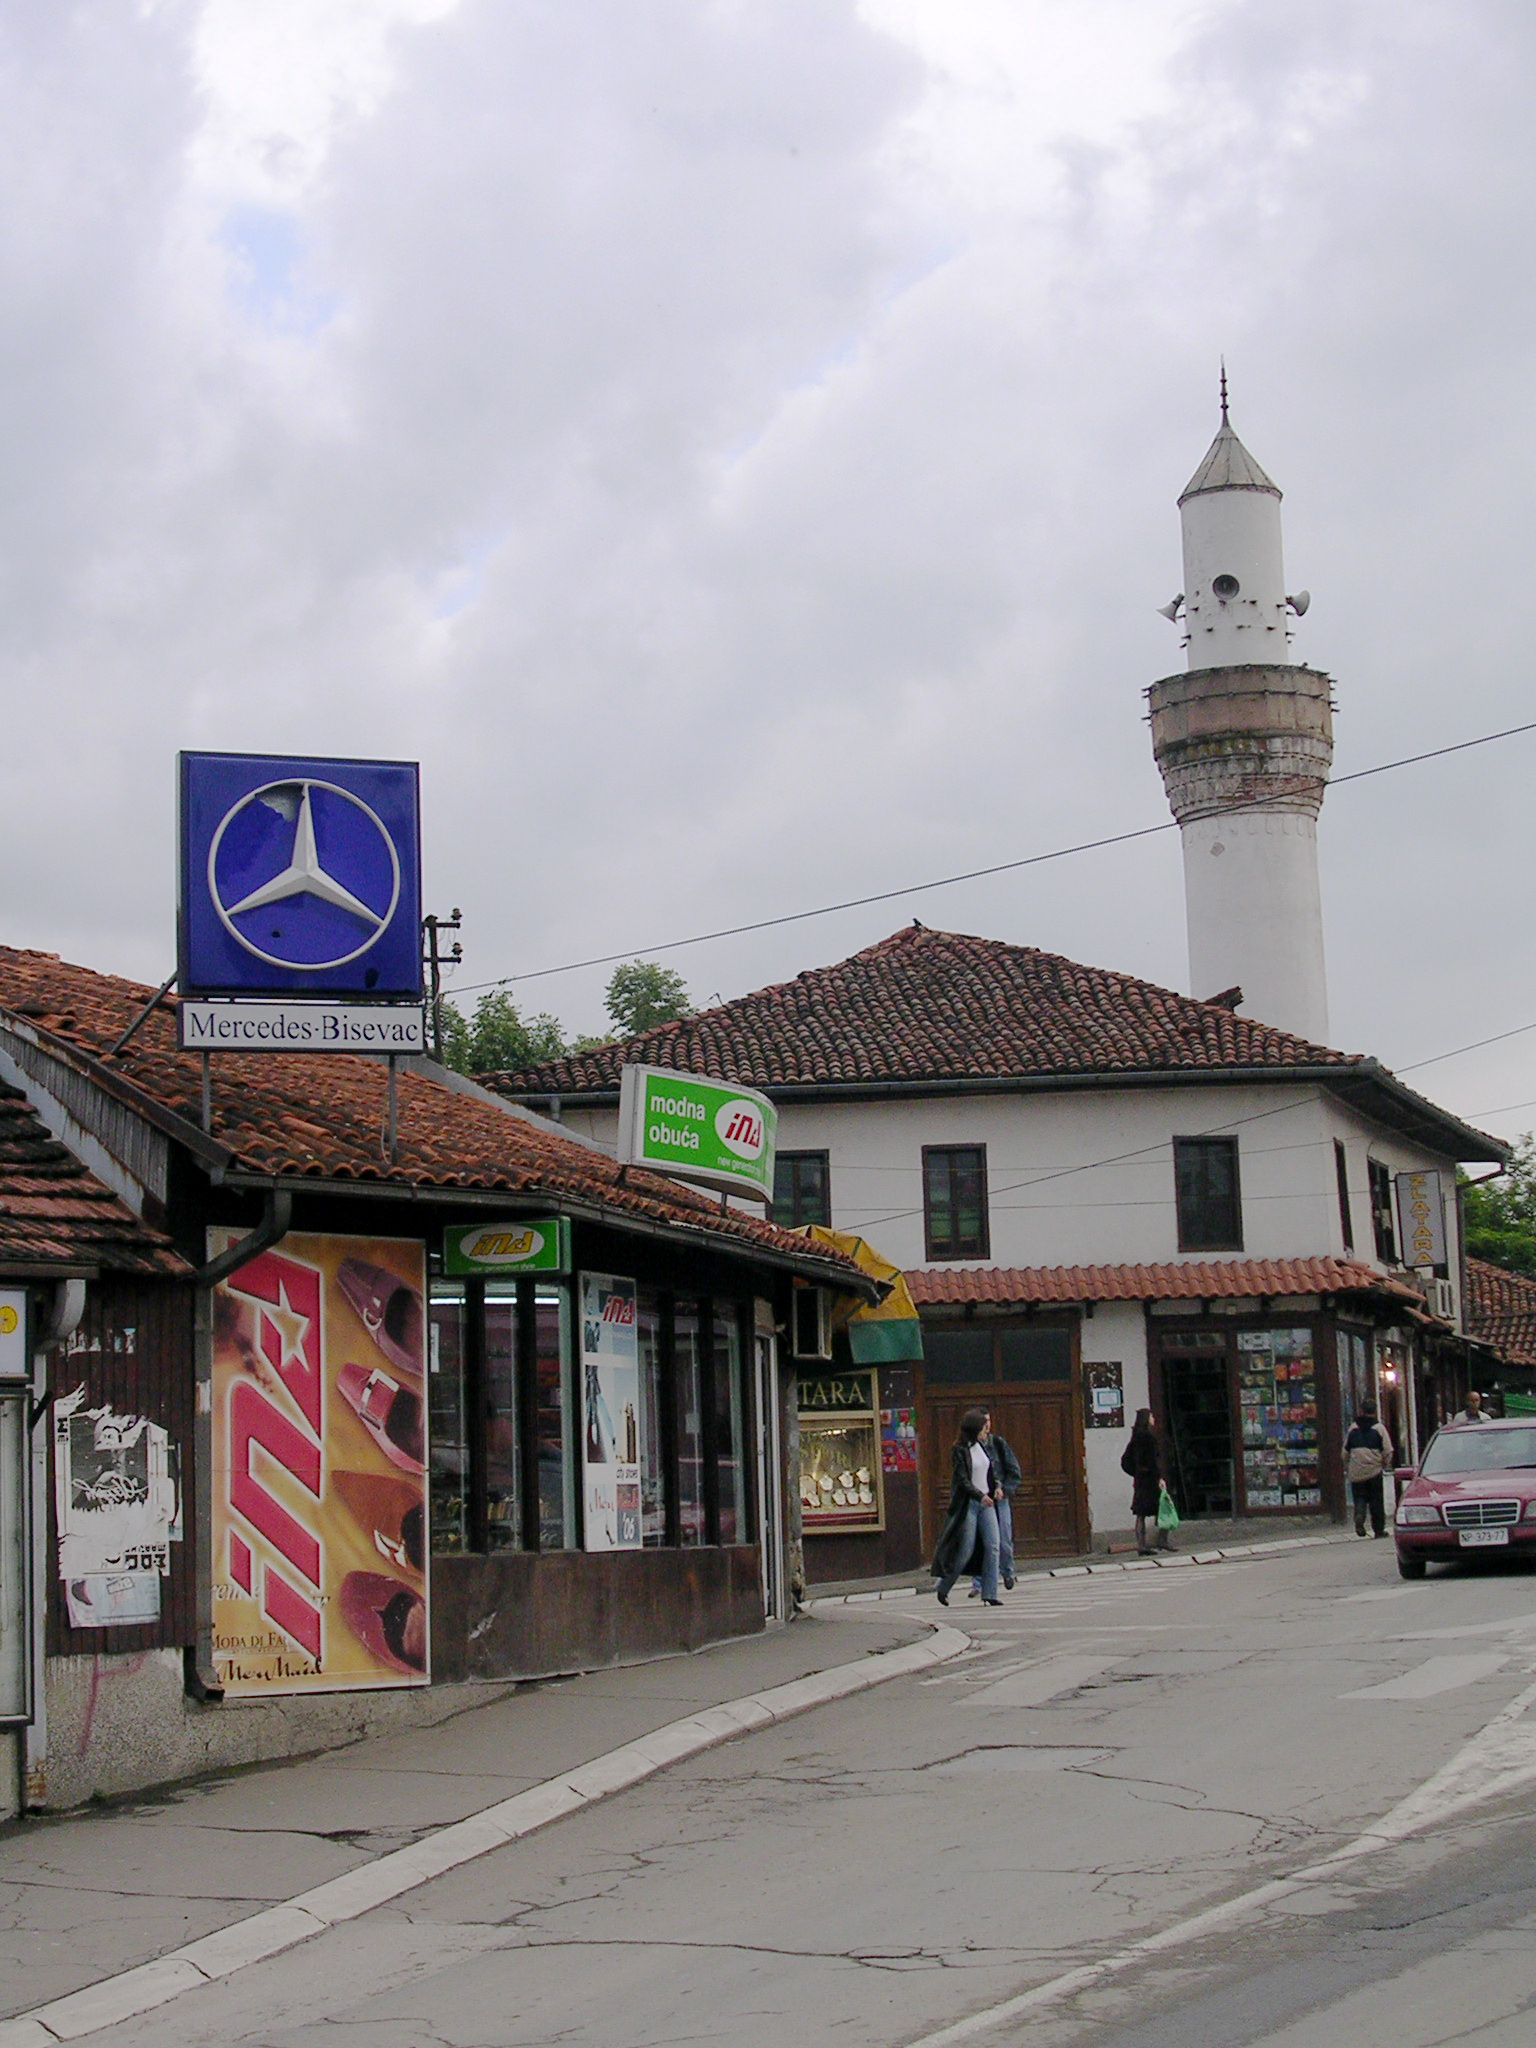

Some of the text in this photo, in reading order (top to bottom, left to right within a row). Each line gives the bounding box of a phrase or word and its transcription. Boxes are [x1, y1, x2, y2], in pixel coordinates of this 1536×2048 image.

[650, 1095, 706, 1121] modna
[648, 1122, 700, 1150] obuća
[1409, 1174, 1434, 1265] ZLATARA
